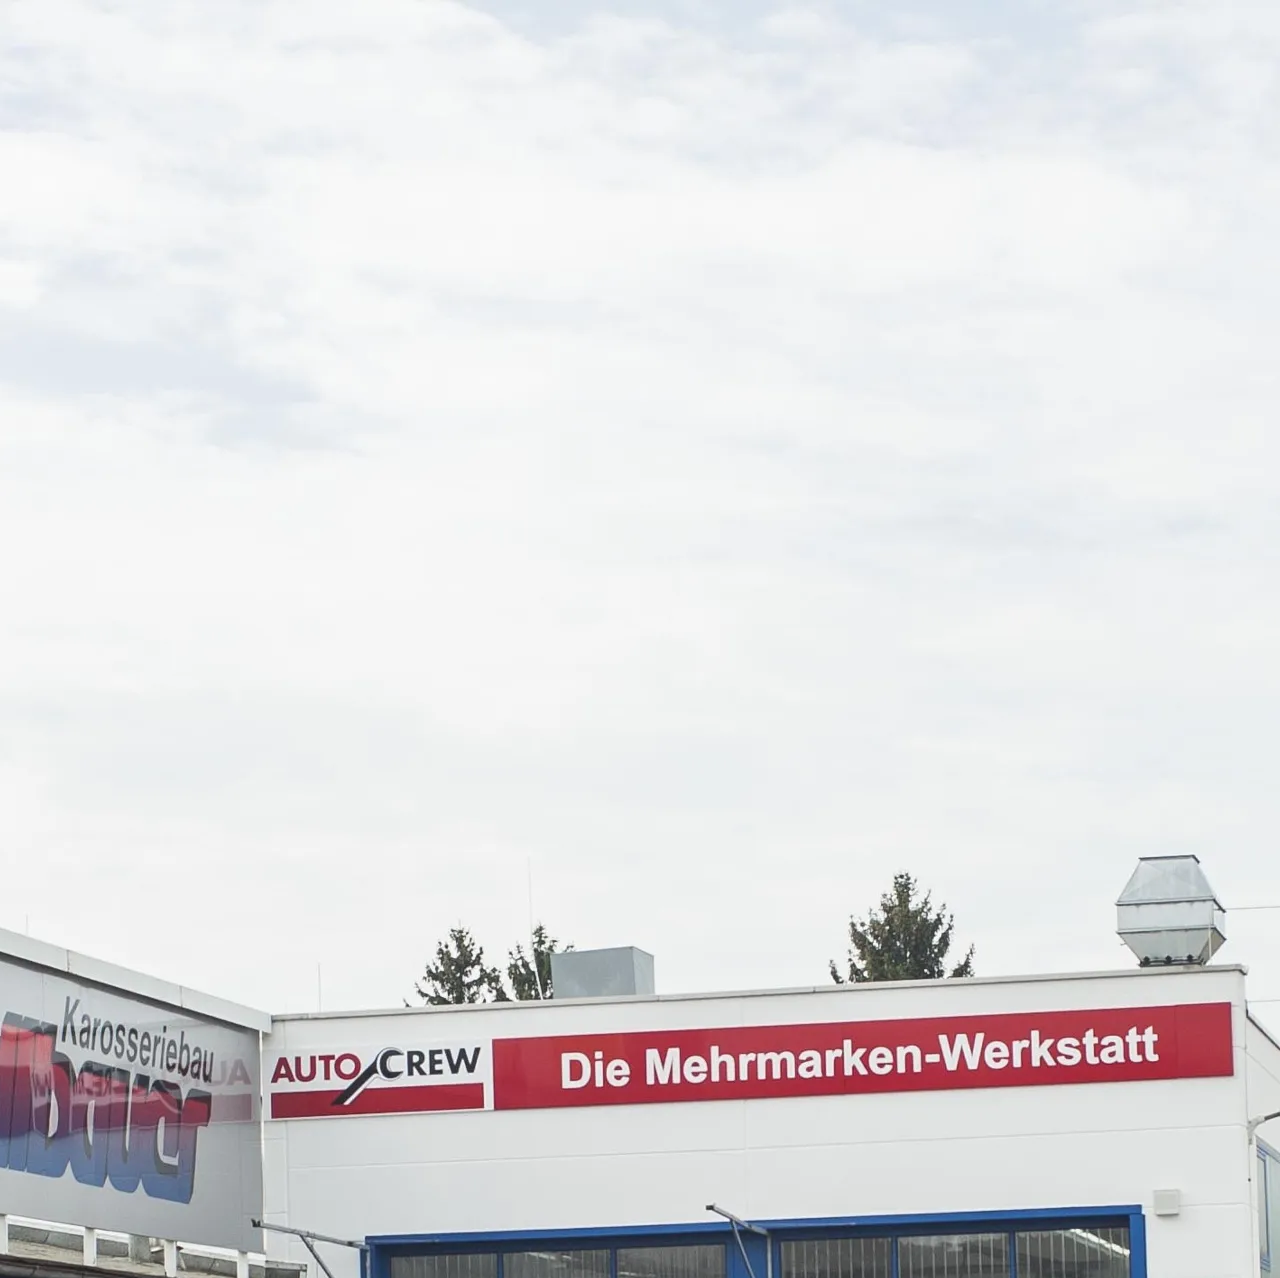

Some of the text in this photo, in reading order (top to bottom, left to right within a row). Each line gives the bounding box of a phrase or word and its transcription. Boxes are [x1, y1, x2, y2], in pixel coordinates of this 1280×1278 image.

[61, 996, 214, 1084] Karosseriebau
[271, 1053, 361, 1084] AUTO
[379, 1047, 481, 1080] CREW
[561, 1026, 1159, 1089] Die Mehrmarken-Werkstatt
